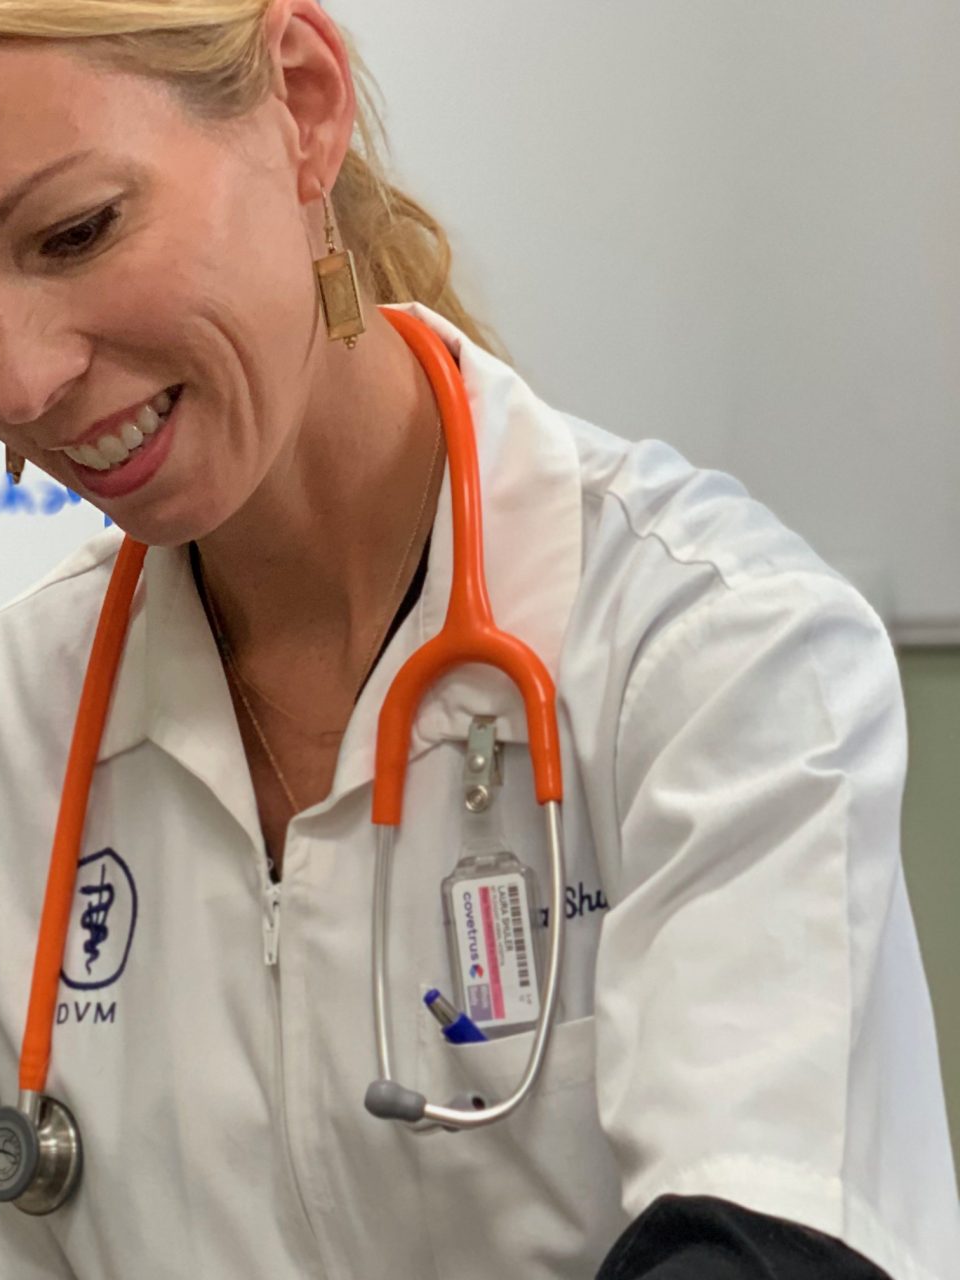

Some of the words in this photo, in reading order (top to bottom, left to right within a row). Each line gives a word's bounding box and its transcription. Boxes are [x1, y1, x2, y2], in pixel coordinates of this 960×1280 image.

[497, 885, 508, 914] LAURA
[463, 891, 479, 961] covetrus
[501, 917, 512, 951] SHULER
[57, 1001, 116, 1024] DVM
